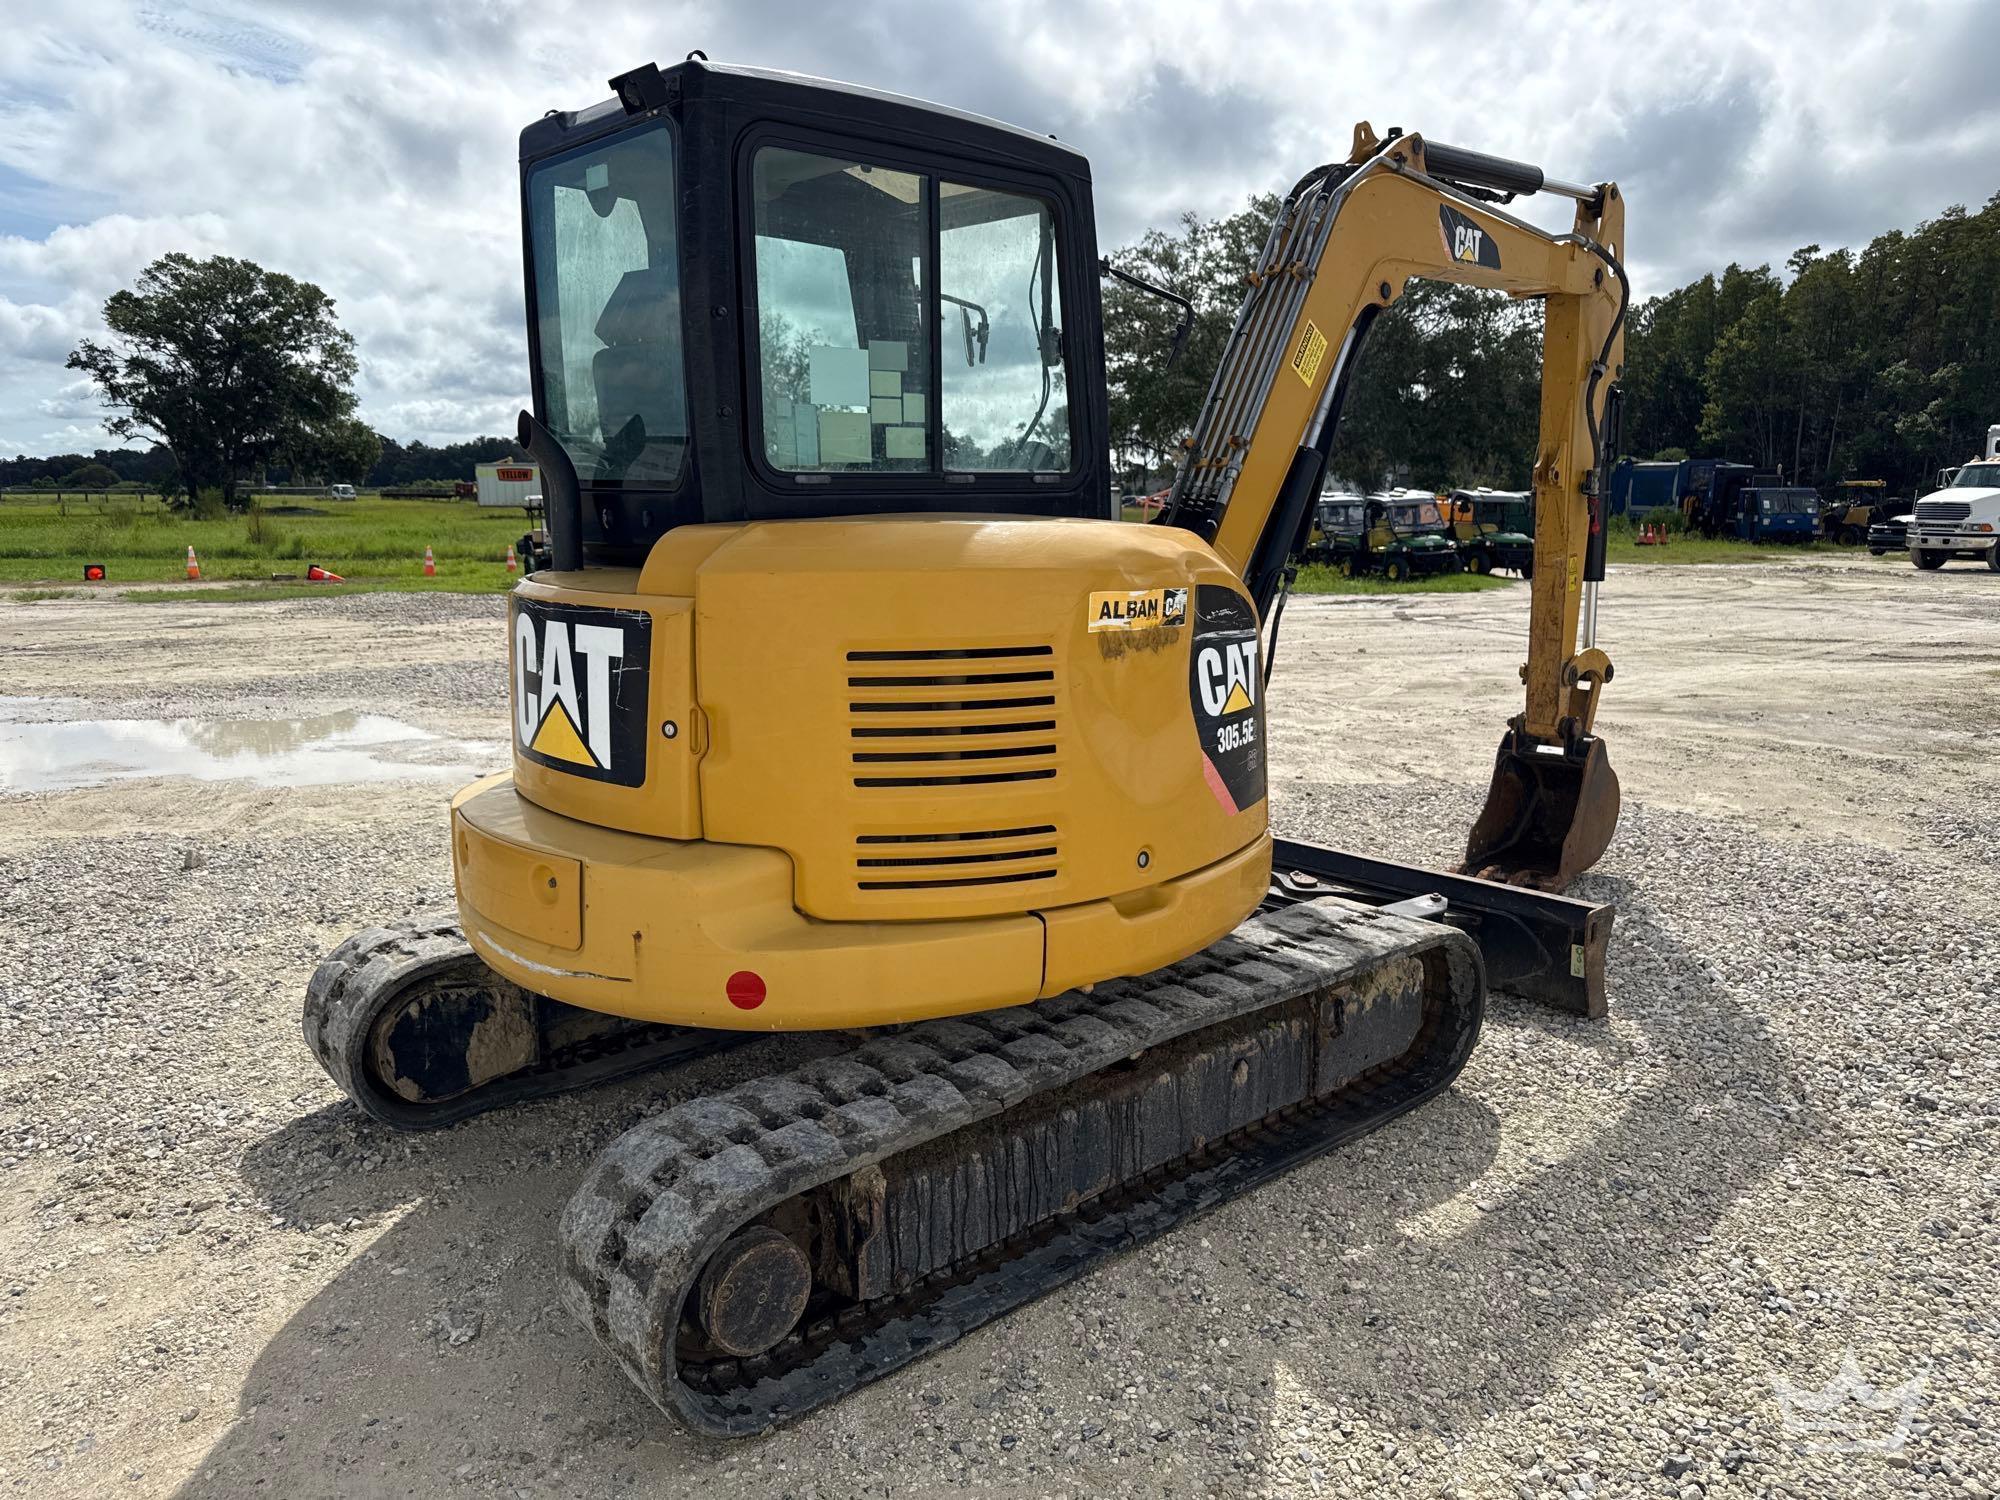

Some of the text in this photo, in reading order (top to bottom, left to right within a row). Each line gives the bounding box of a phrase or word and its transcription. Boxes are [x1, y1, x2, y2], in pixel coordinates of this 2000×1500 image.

[1455, 225, 1483, 263] CAT
[1294, 324, 1314, 367] WARNING
[501, 470, 529, 479] YELLOW
[1099, 599, 1159, 620] ALBAN
[516, 612, 624, 770] CAT
[1198, 640, 1257, 717] CAT
